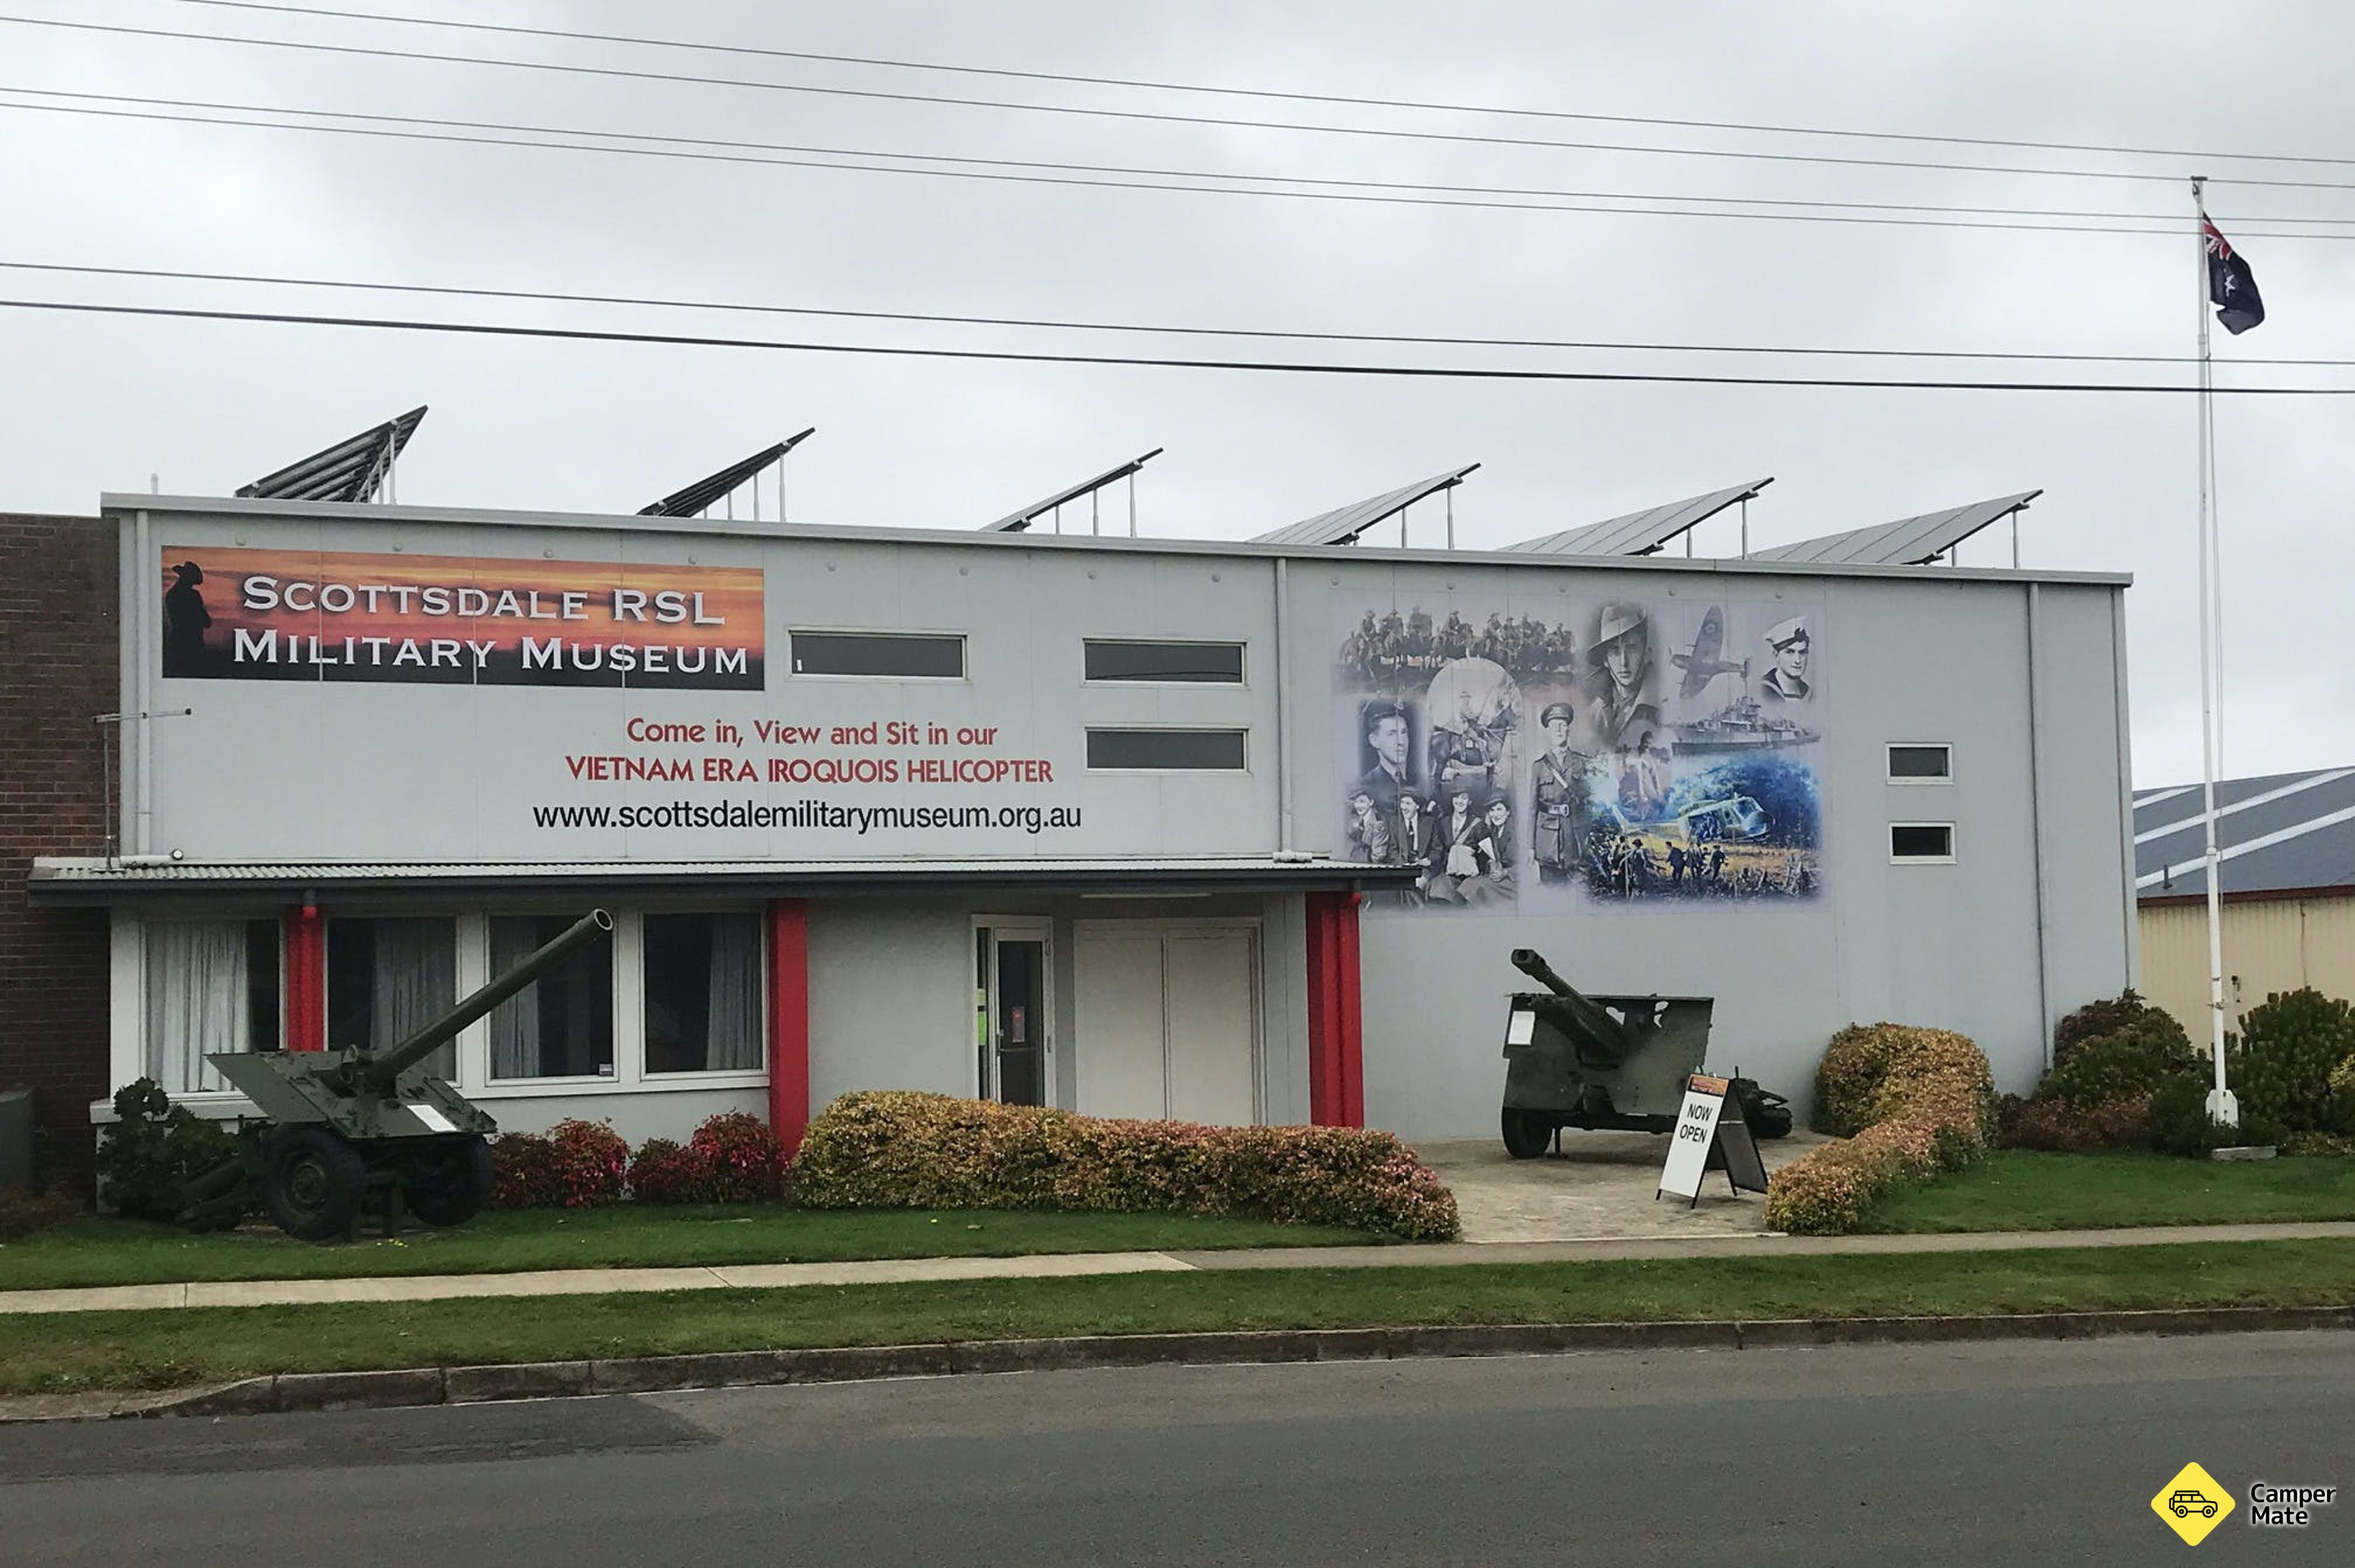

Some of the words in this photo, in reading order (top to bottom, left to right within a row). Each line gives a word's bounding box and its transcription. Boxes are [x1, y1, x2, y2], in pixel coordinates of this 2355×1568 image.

[243, 575, 589, 622] SCOTTSDALE
[613, 588, 726, 626] RSL
[233, 627, 496, 669] MILITARY
[520, 636, 747, 676] MUSEUM
[626, 717, 706, 745] Come
[715, 719, 743, 748] in,
[753, 720, 822, 745] View
[831, 721, 878, 745] and
[886, 722, 919, 746] Sit
[928, 722, 949, 746] in
[957, 728, 998, 746] our
[566, 756, 695, 782] VIETNAM
[703, 758, 759, 783] ERA
[768, 759, 898, 785] IROQUOIS
[907, 760, 1054, 783] HELICOPTER
[533, 799, 1082, 835] www.scottsdalemilitarymuseum.org.au
[1687, 1104, 1713, 1121] NOW
[1680, 1124, 1707, 1144] OPEN
